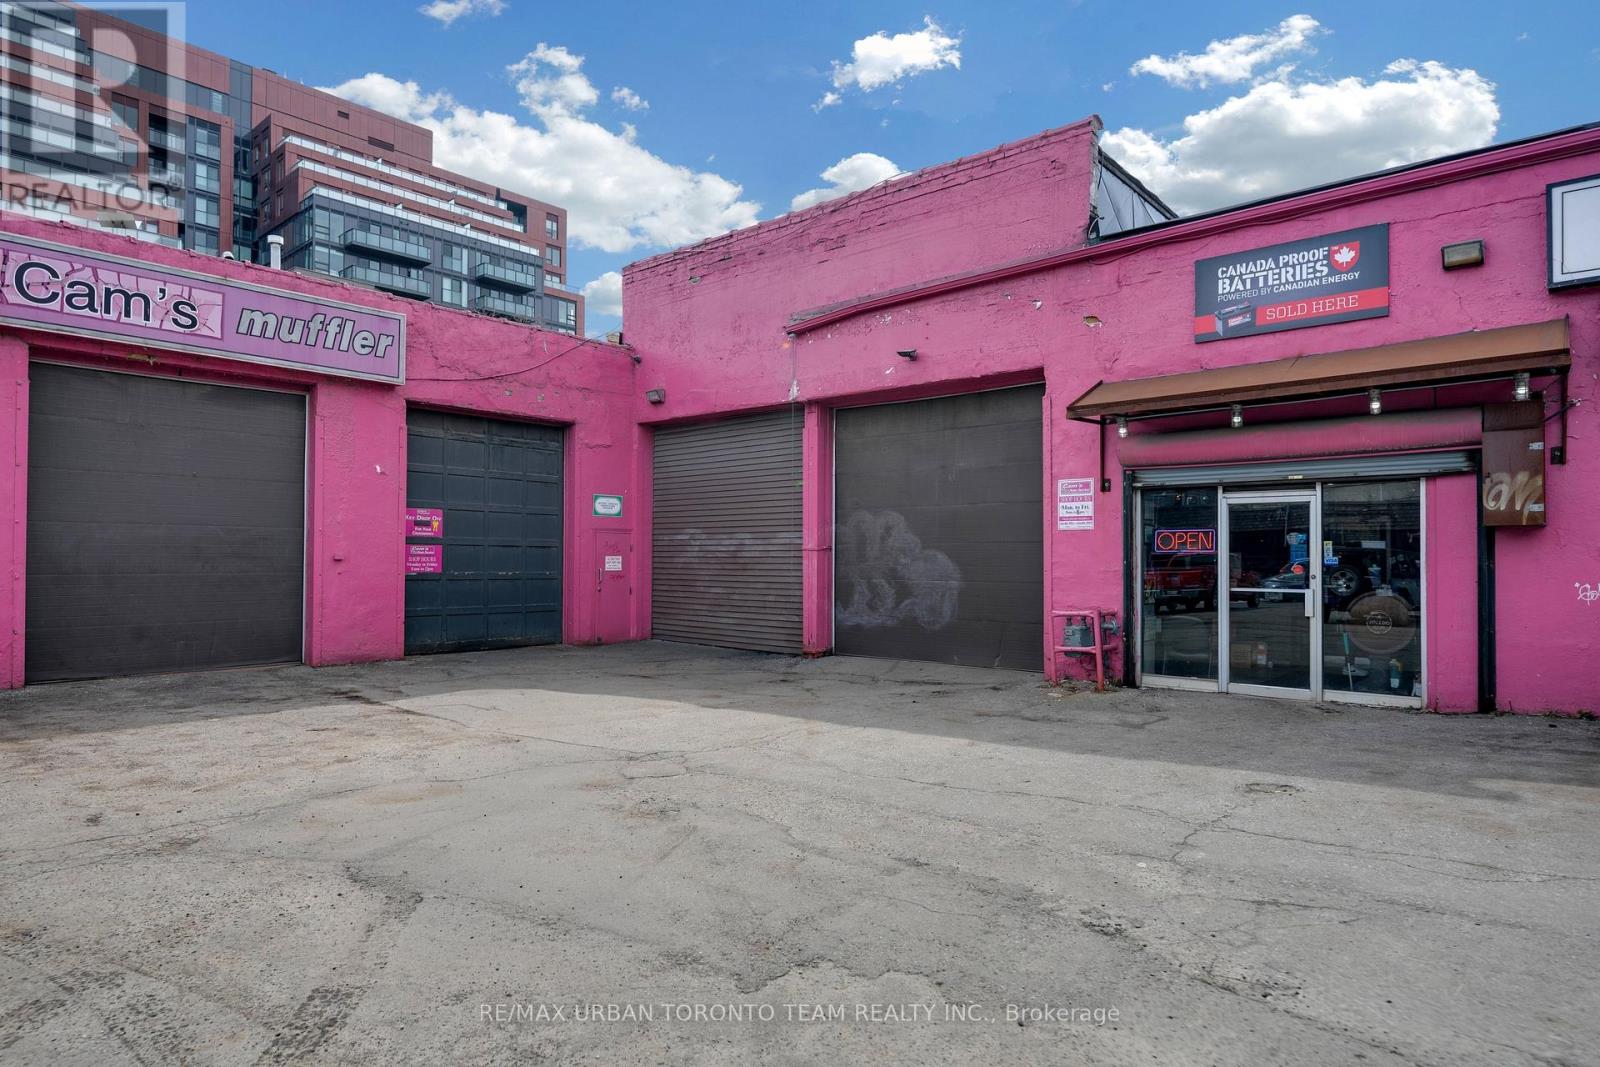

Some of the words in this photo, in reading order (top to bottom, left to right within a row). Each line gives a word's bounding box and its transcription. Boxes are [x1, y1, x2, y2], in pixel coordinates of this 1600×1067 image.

[1217, 257, 1275, 278] CANADA
[1279, 246, 1329, 267] PROOF
[1217, 260, 1329, 295] BATTERIES
[1217, 288, 1259, 303] POWERED
[1260, 287, 1273, 296] BY
[1273, 279, 1320, 293] CANADIAN
[1322, 271, 1361, 285] ENERGY
[13, 260, 200, 332] Cam's
[236, 306, 394, 359] muffler
[1266, 303, 1308, 321] SOLD
[1312, 294, 1359, 314] HERE
[1157, 531, 1213, 550] OPEN
